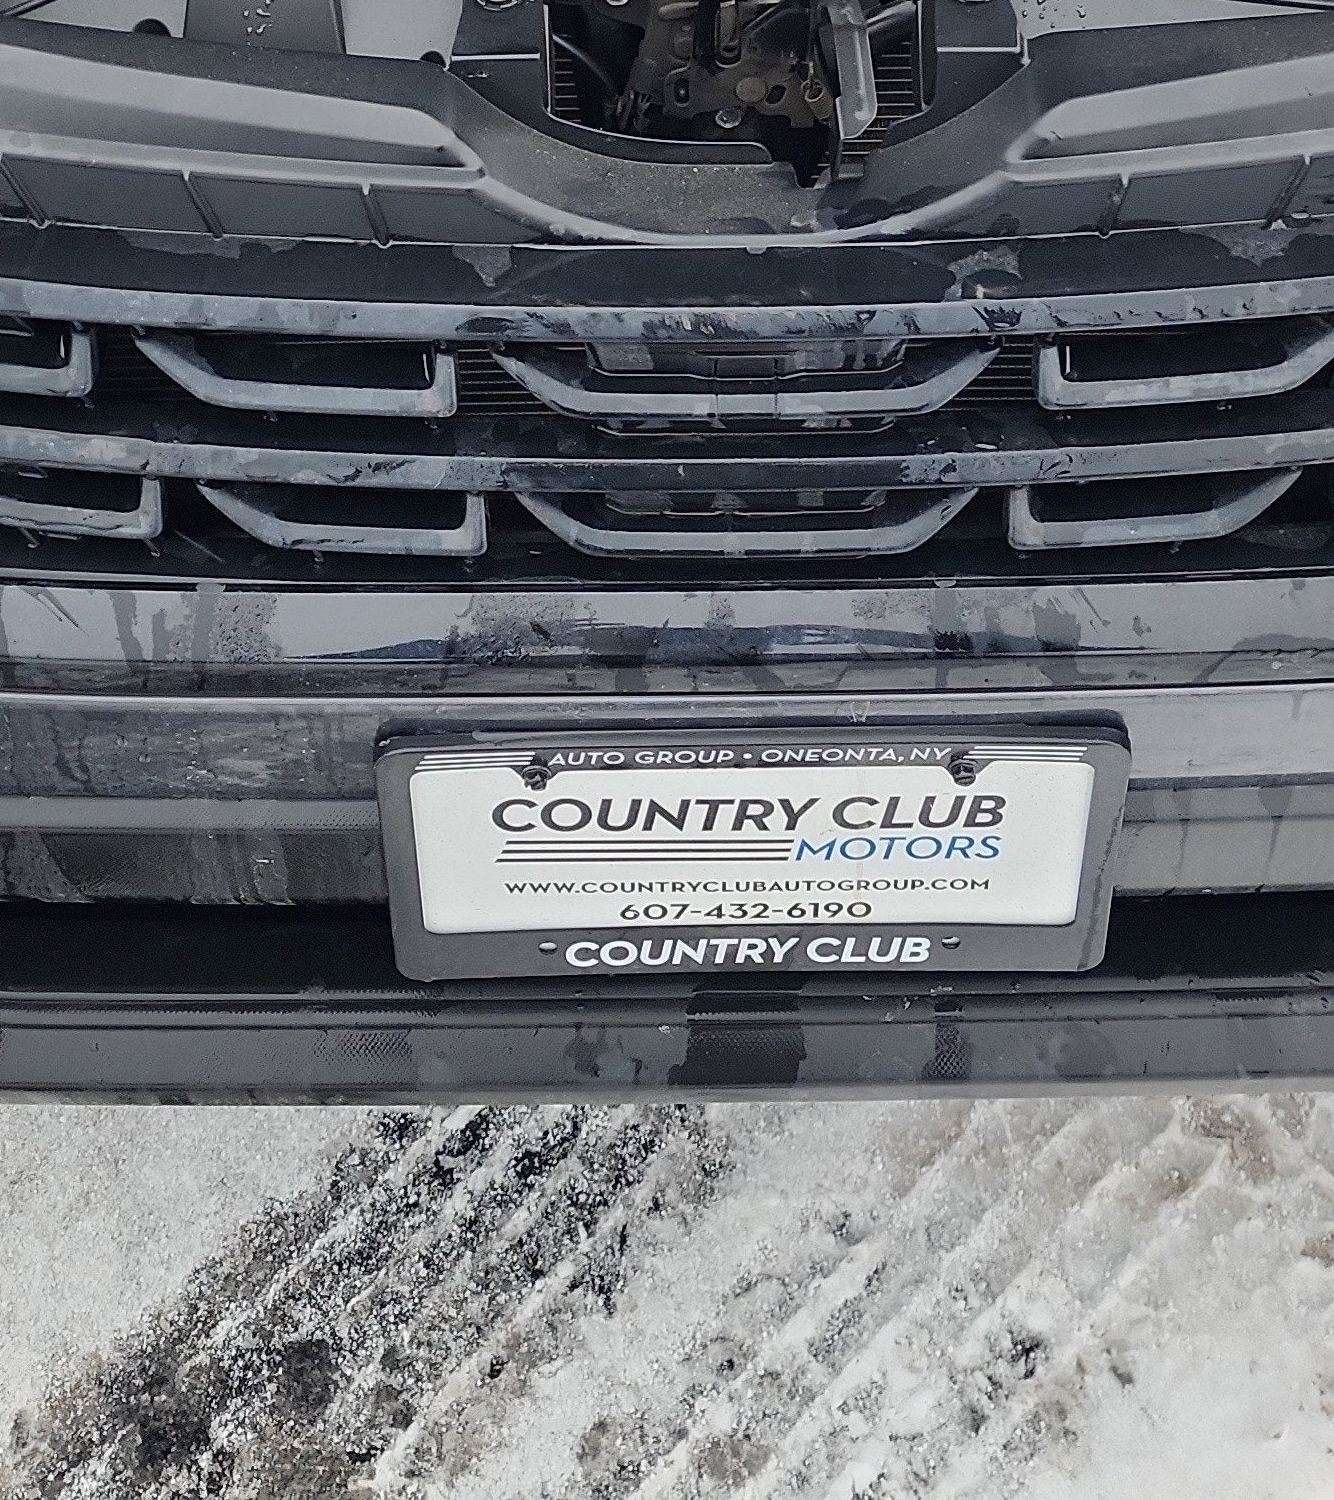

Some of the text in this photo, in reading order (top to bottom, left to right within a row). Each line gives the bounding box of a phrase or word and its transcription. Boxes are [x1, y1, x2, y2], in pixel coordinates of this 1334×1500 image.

[548, 747, 952, 766] AUTO GROUP ONEONTA, NY
[492, 795, 1007, 832] COUNTRY CLUB
[795, 836, 1002, 861] MOTORS
[504, 879, 990, 894] WWW.COUNTRYCLUBAUTOGROUP.COM
[619, 902, 872, 920] 607-432-6190
[565, 937, 932, 967] COUNTRY CLUB
